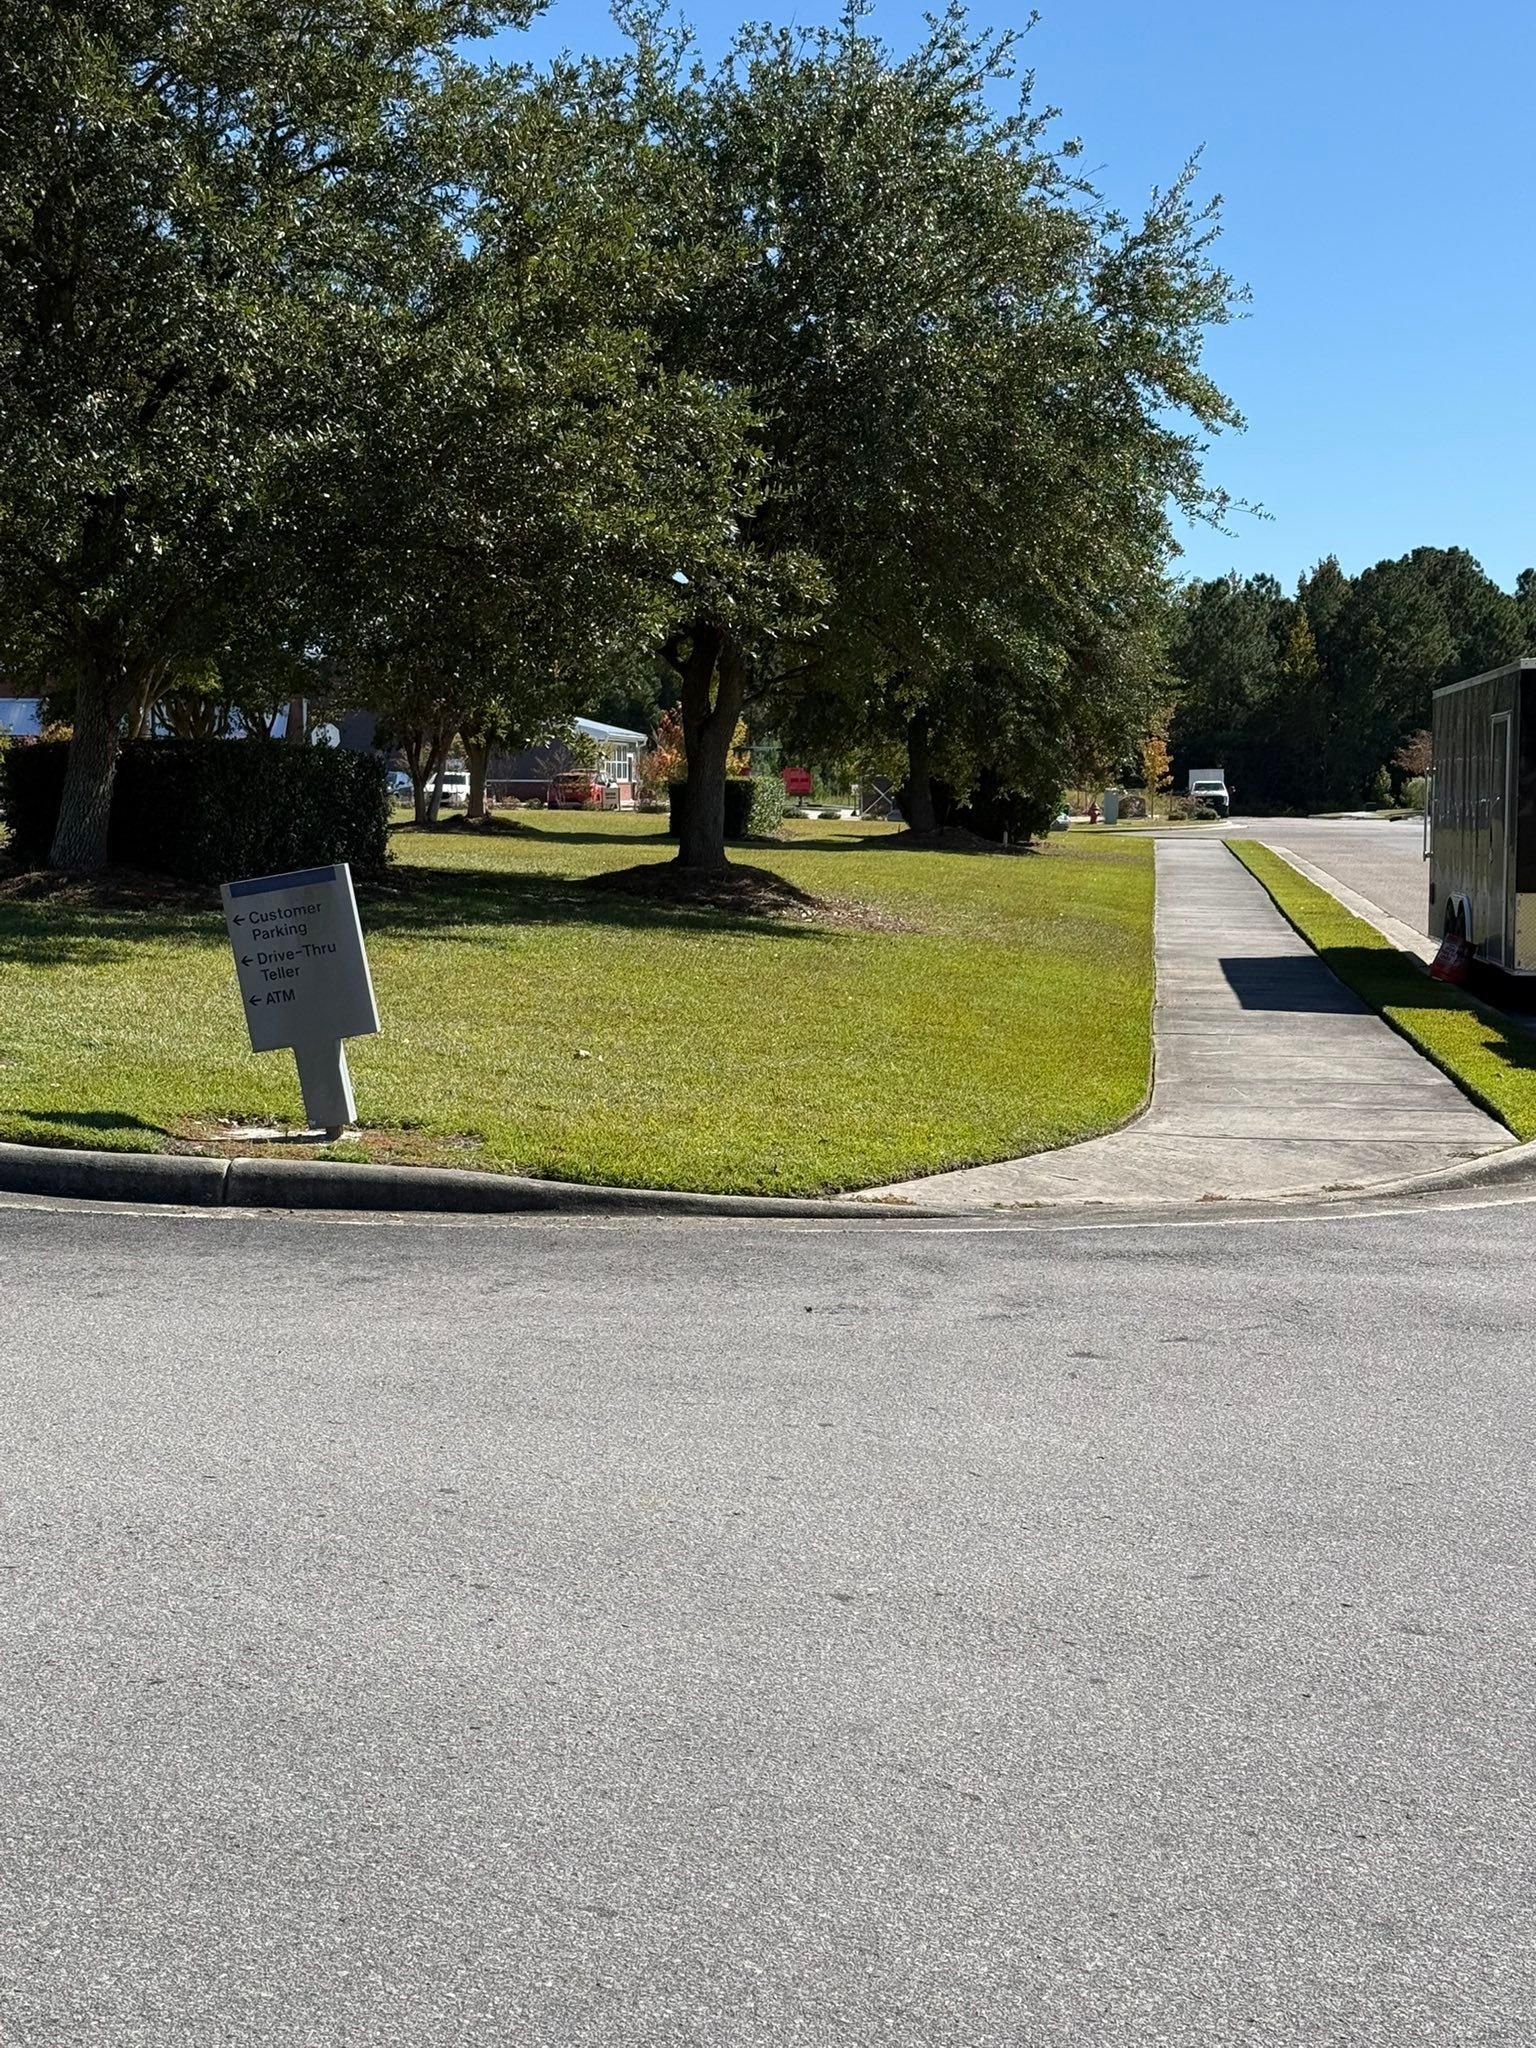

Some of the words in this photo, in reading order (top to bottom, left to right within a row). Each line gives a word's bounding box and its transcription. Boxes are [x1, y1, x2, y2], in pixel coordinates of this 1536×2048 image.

[249, 903, 322, 924] Customer
[252, 923, 308, 941] Parking
[257, 943, 336, 965] Drive-Thru
[261, 966, 301, 982] Teller
[266, 989, 296, 1005] ATM
